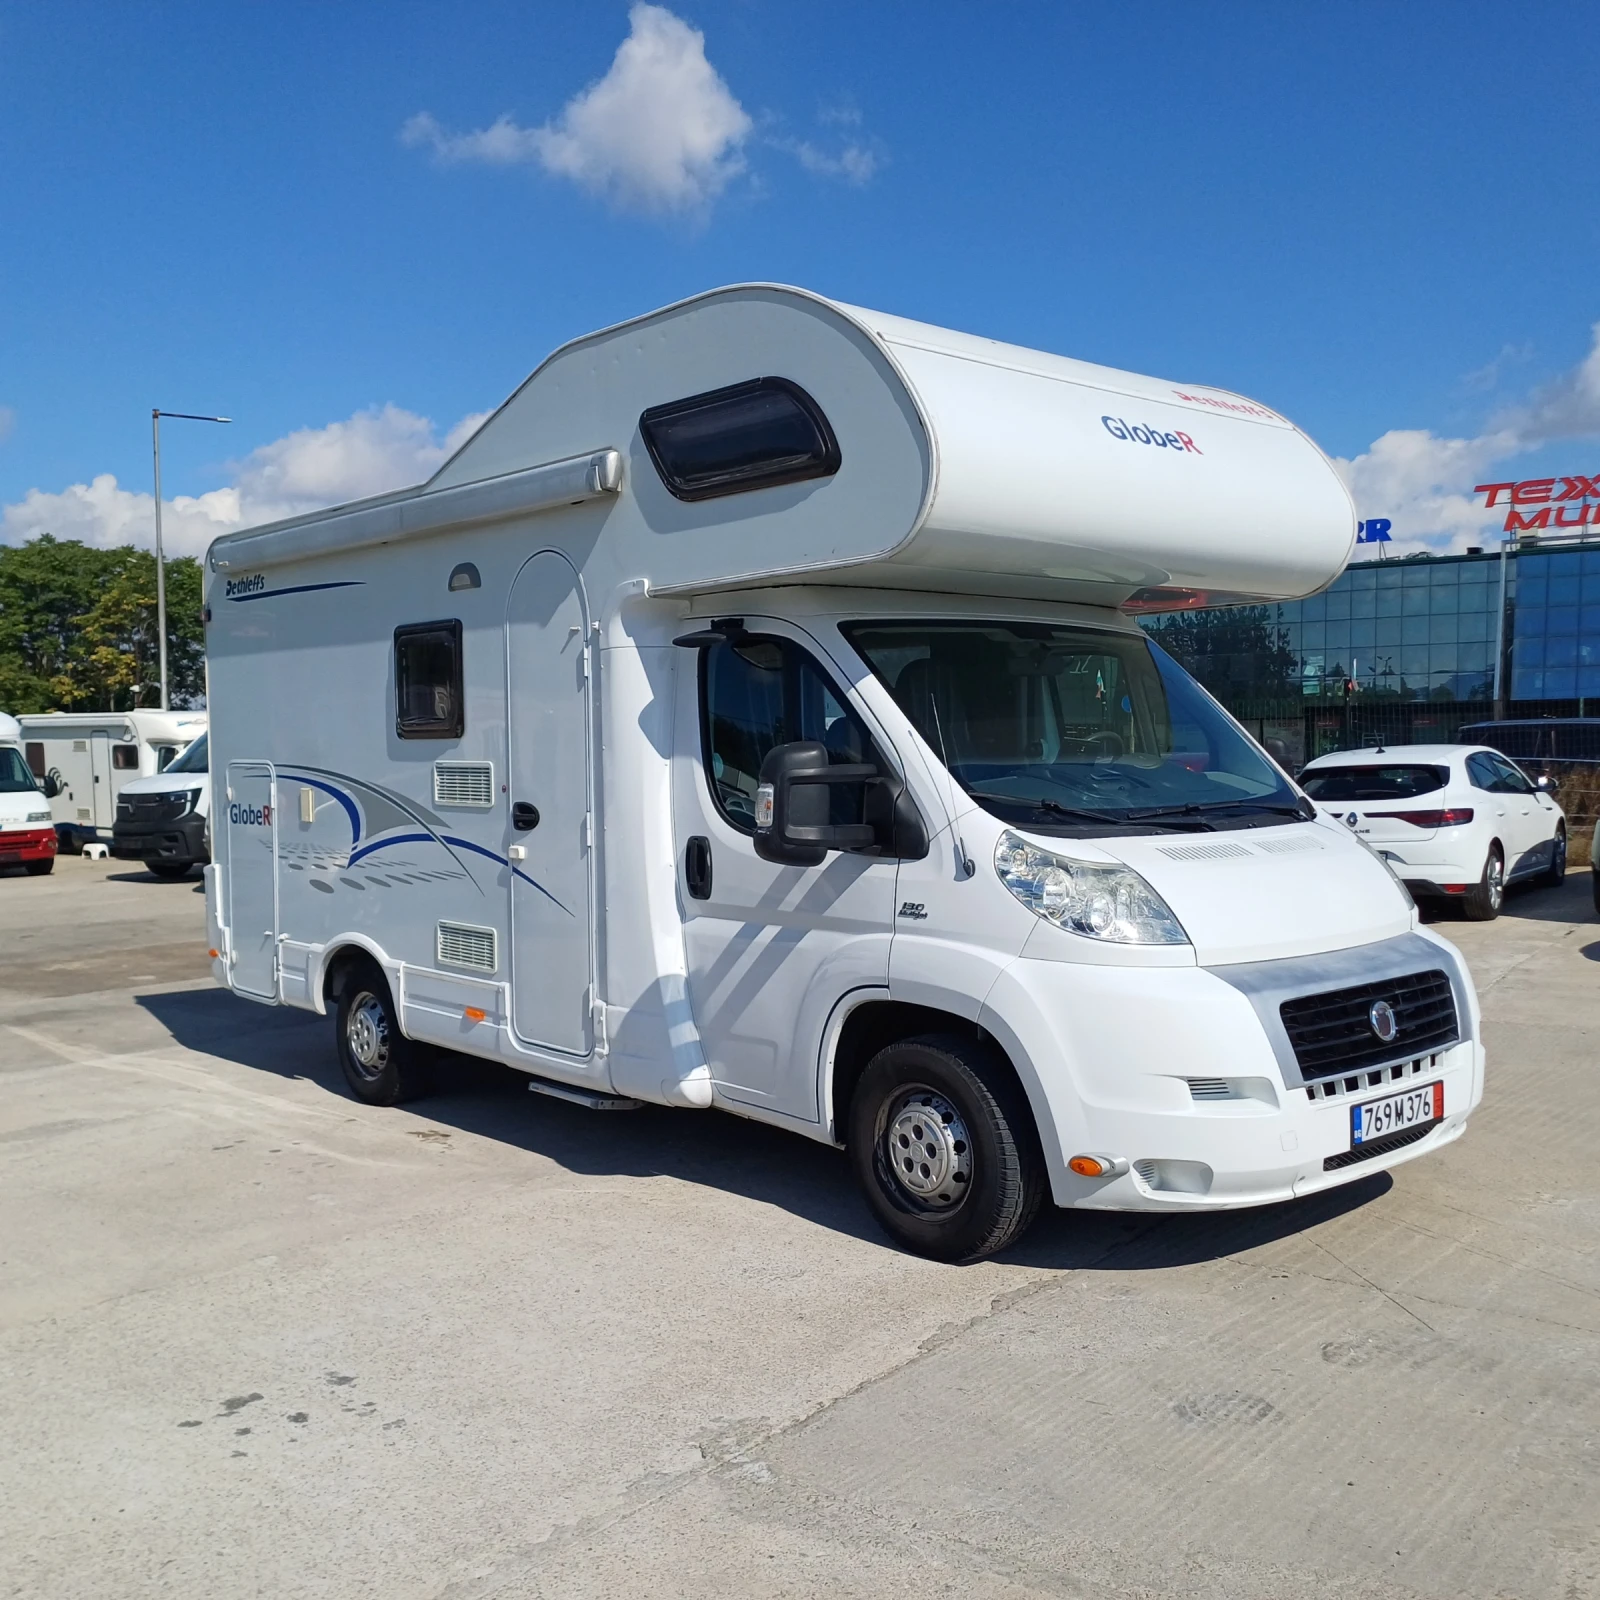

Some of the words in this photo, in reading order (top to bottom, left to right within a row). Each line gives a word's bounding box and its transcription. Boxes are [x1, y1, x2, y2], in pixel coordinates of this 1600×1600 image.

[1101, 415, 1204, 455] GlobeR
[1503, 503, 1600, 532] MU
[226, 573, 265, 597] Dethleffs
[230, 803, 272, 826] GlobeR
